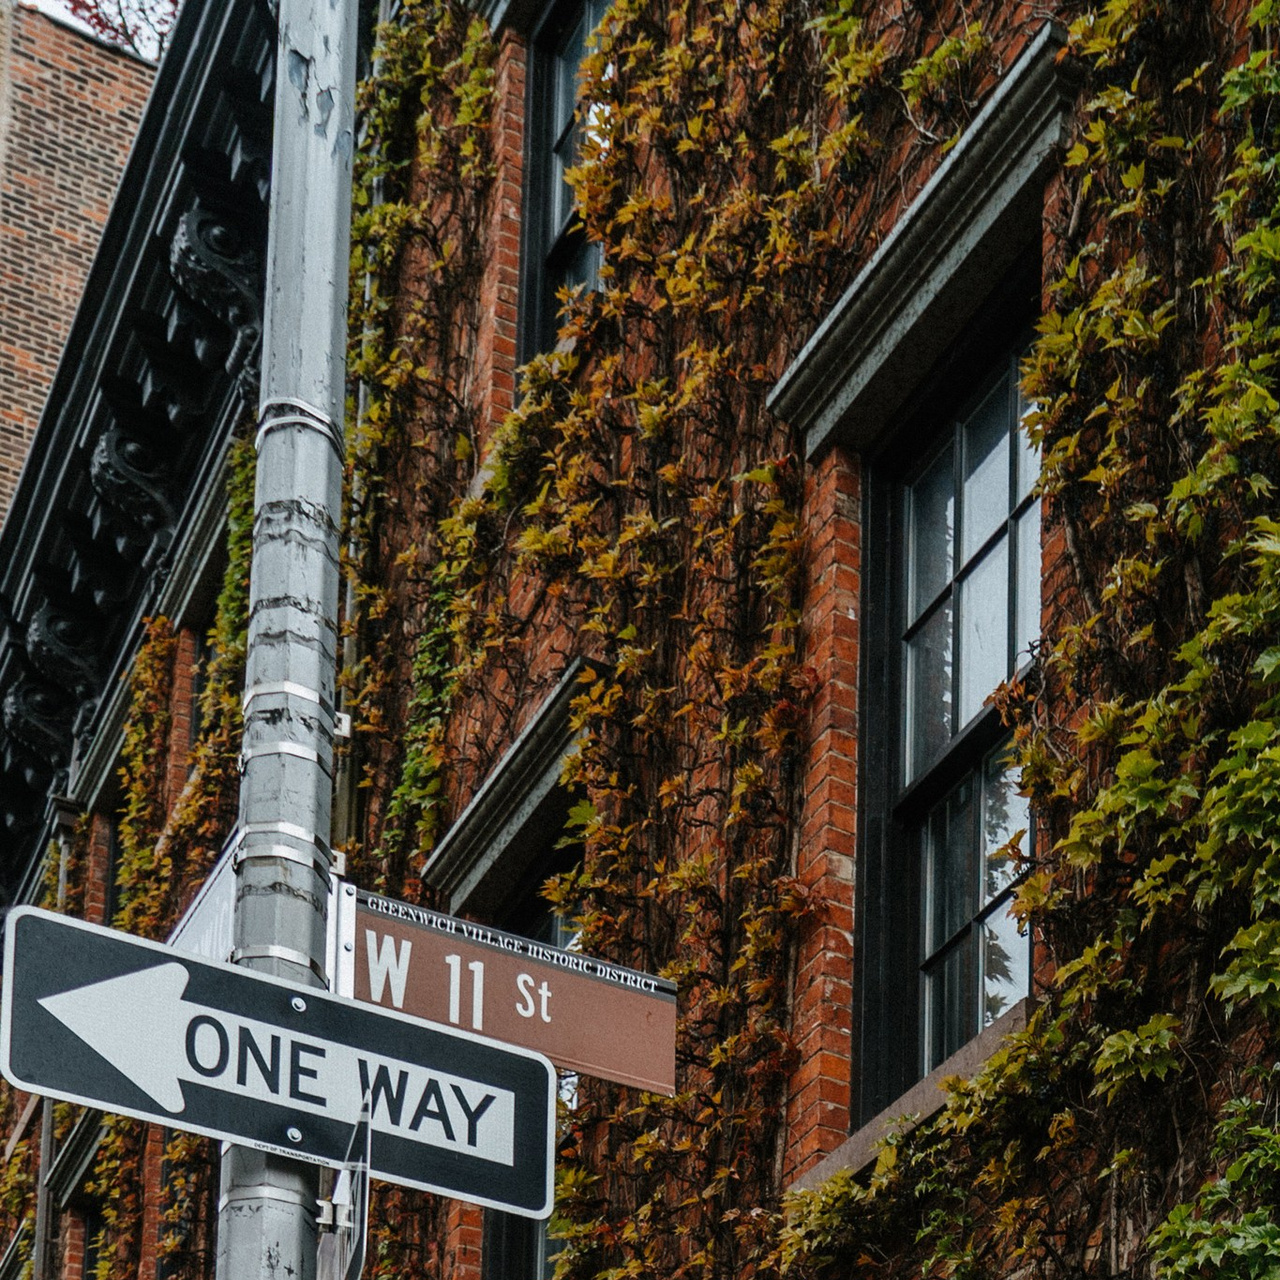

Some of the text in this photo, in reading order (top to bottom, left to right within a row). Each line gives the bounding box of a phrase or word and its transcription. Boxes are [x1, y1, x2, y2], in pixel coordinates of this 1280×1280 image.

[365, 929, 552, 1031] W 11 St
[367, 896, 658, 993] GREENWICH VILLAGE HISTORIC DISTRICT
[185, 1014, 497, 1147] ONE WAY
[279, 1148, 330, 1166] TRANSPORTATION
